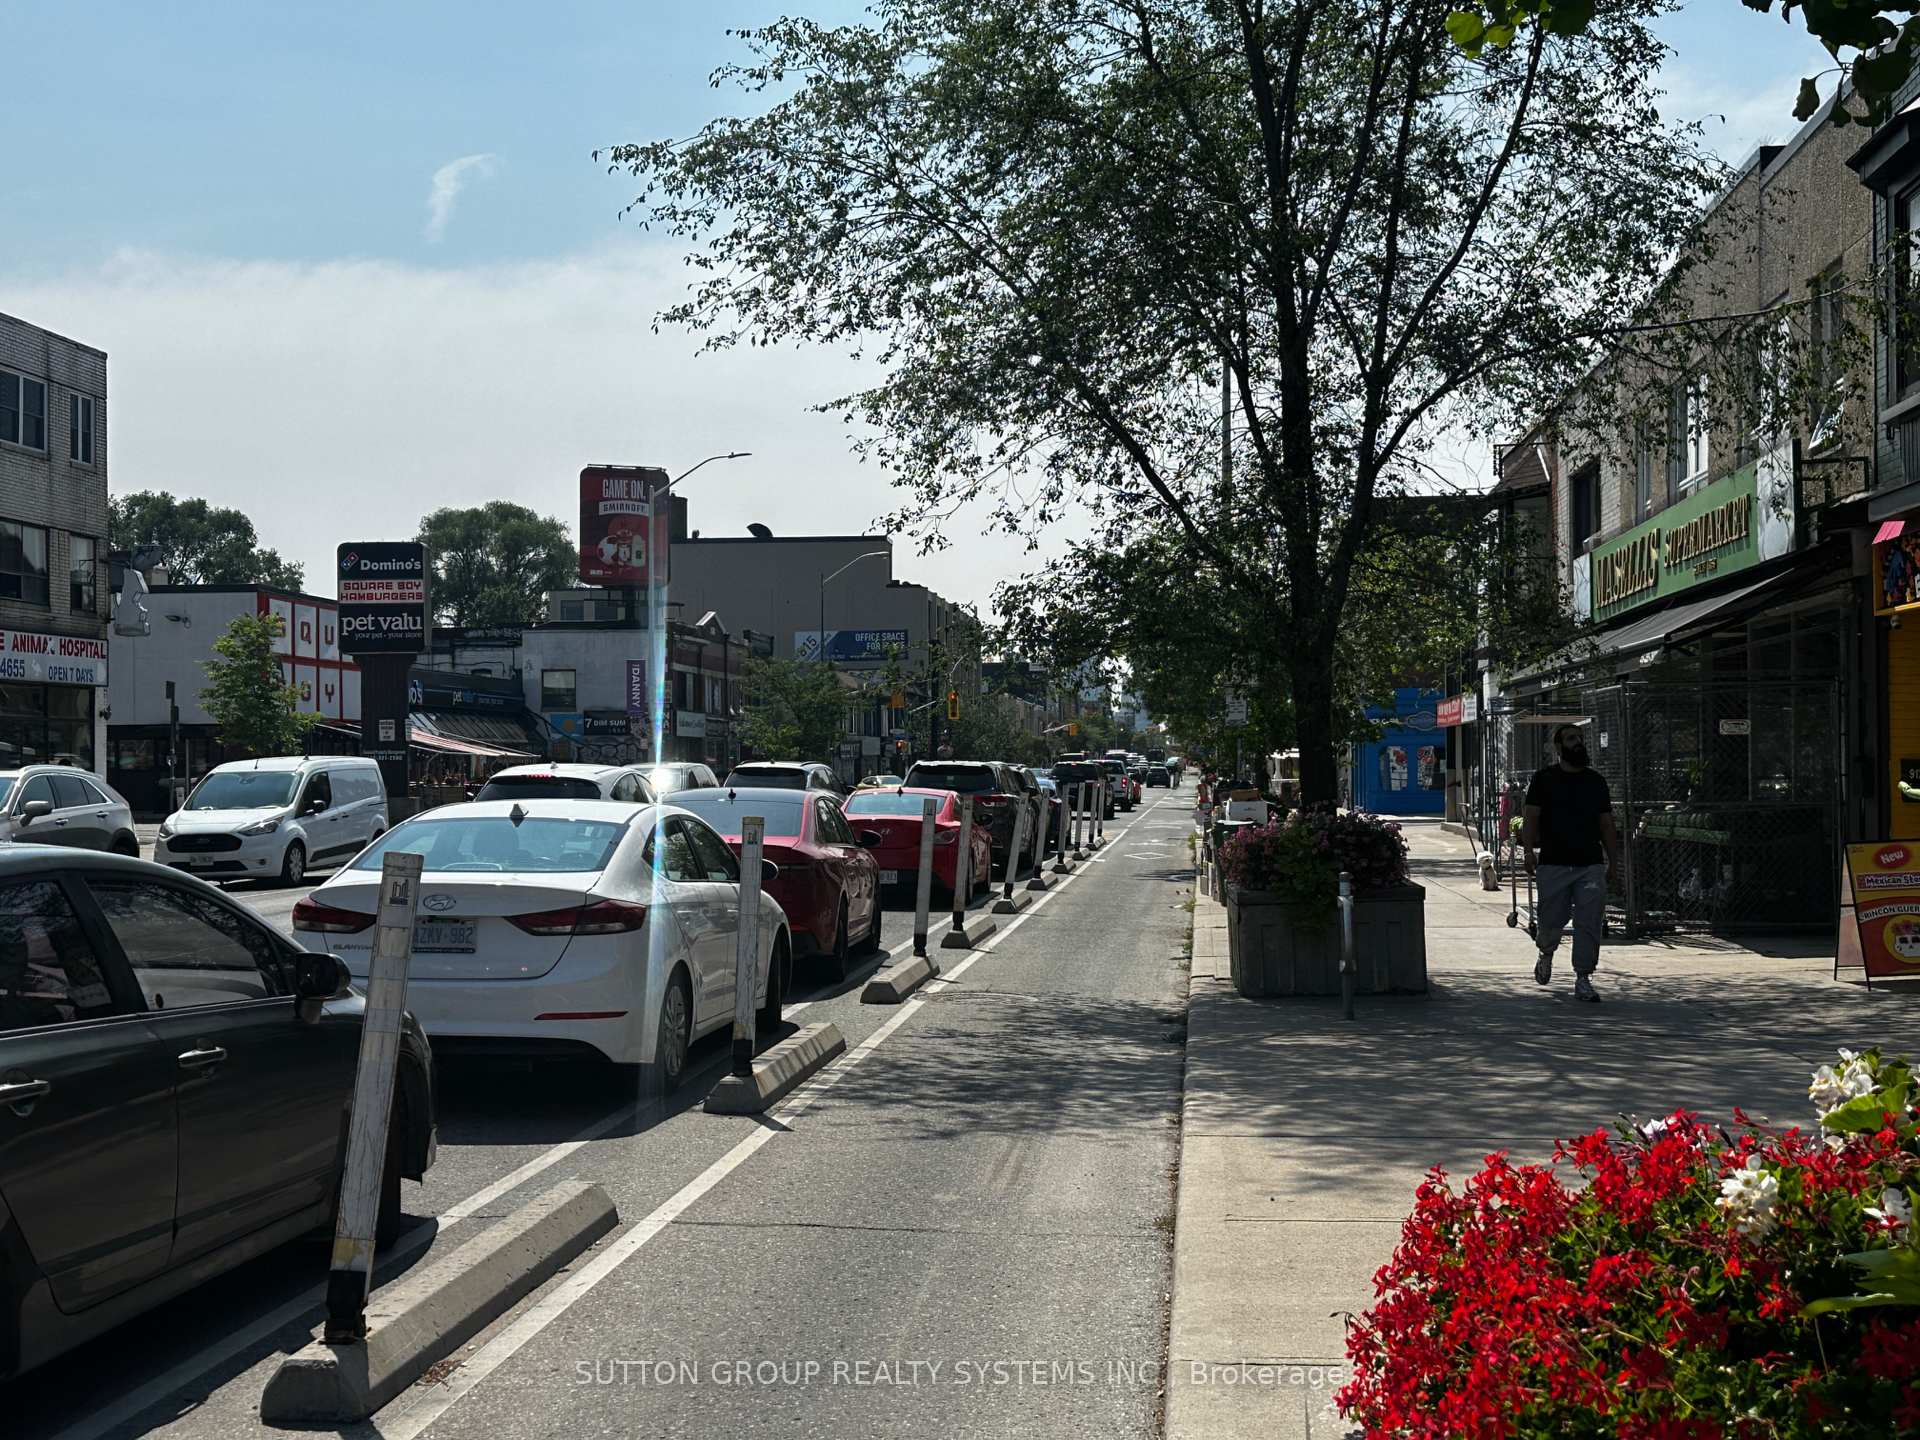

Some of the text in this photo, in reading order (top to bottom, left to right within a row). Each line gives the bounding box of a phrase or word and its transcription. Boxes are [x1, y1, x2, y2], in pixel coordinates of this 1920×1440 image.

[602, 480, 629, 499] GAME
[603, 502, 646, 513] SMIRNOFF
[1664, 493, 1751, 568] SUPERMARKET
[360, 558, 421, 571] Domino's
[343, 581, 422, 591] SQUARE BOY
[340, 591, 423, 600] HAMBURGERS
[341, 613, 423, 636] pet valu
[855, 632, 905, 642] OFFICE SPACE
[59, 637, 107, 659] HOSPITAL
[866, 642, 881, 650] FOR
[48, 665, 68, 681] OPEN
[70, 667, 76, 681] 7
[75, 667, 94, 683] DAYS
[631, 667, 641, 708] DANNY
[609, 719, 626, 727] SUM
[1880, 849, 1905, 864] New
[1866, 876, 1902, 886] Mexican
[1864, 906, 1896, 919] RINCON
